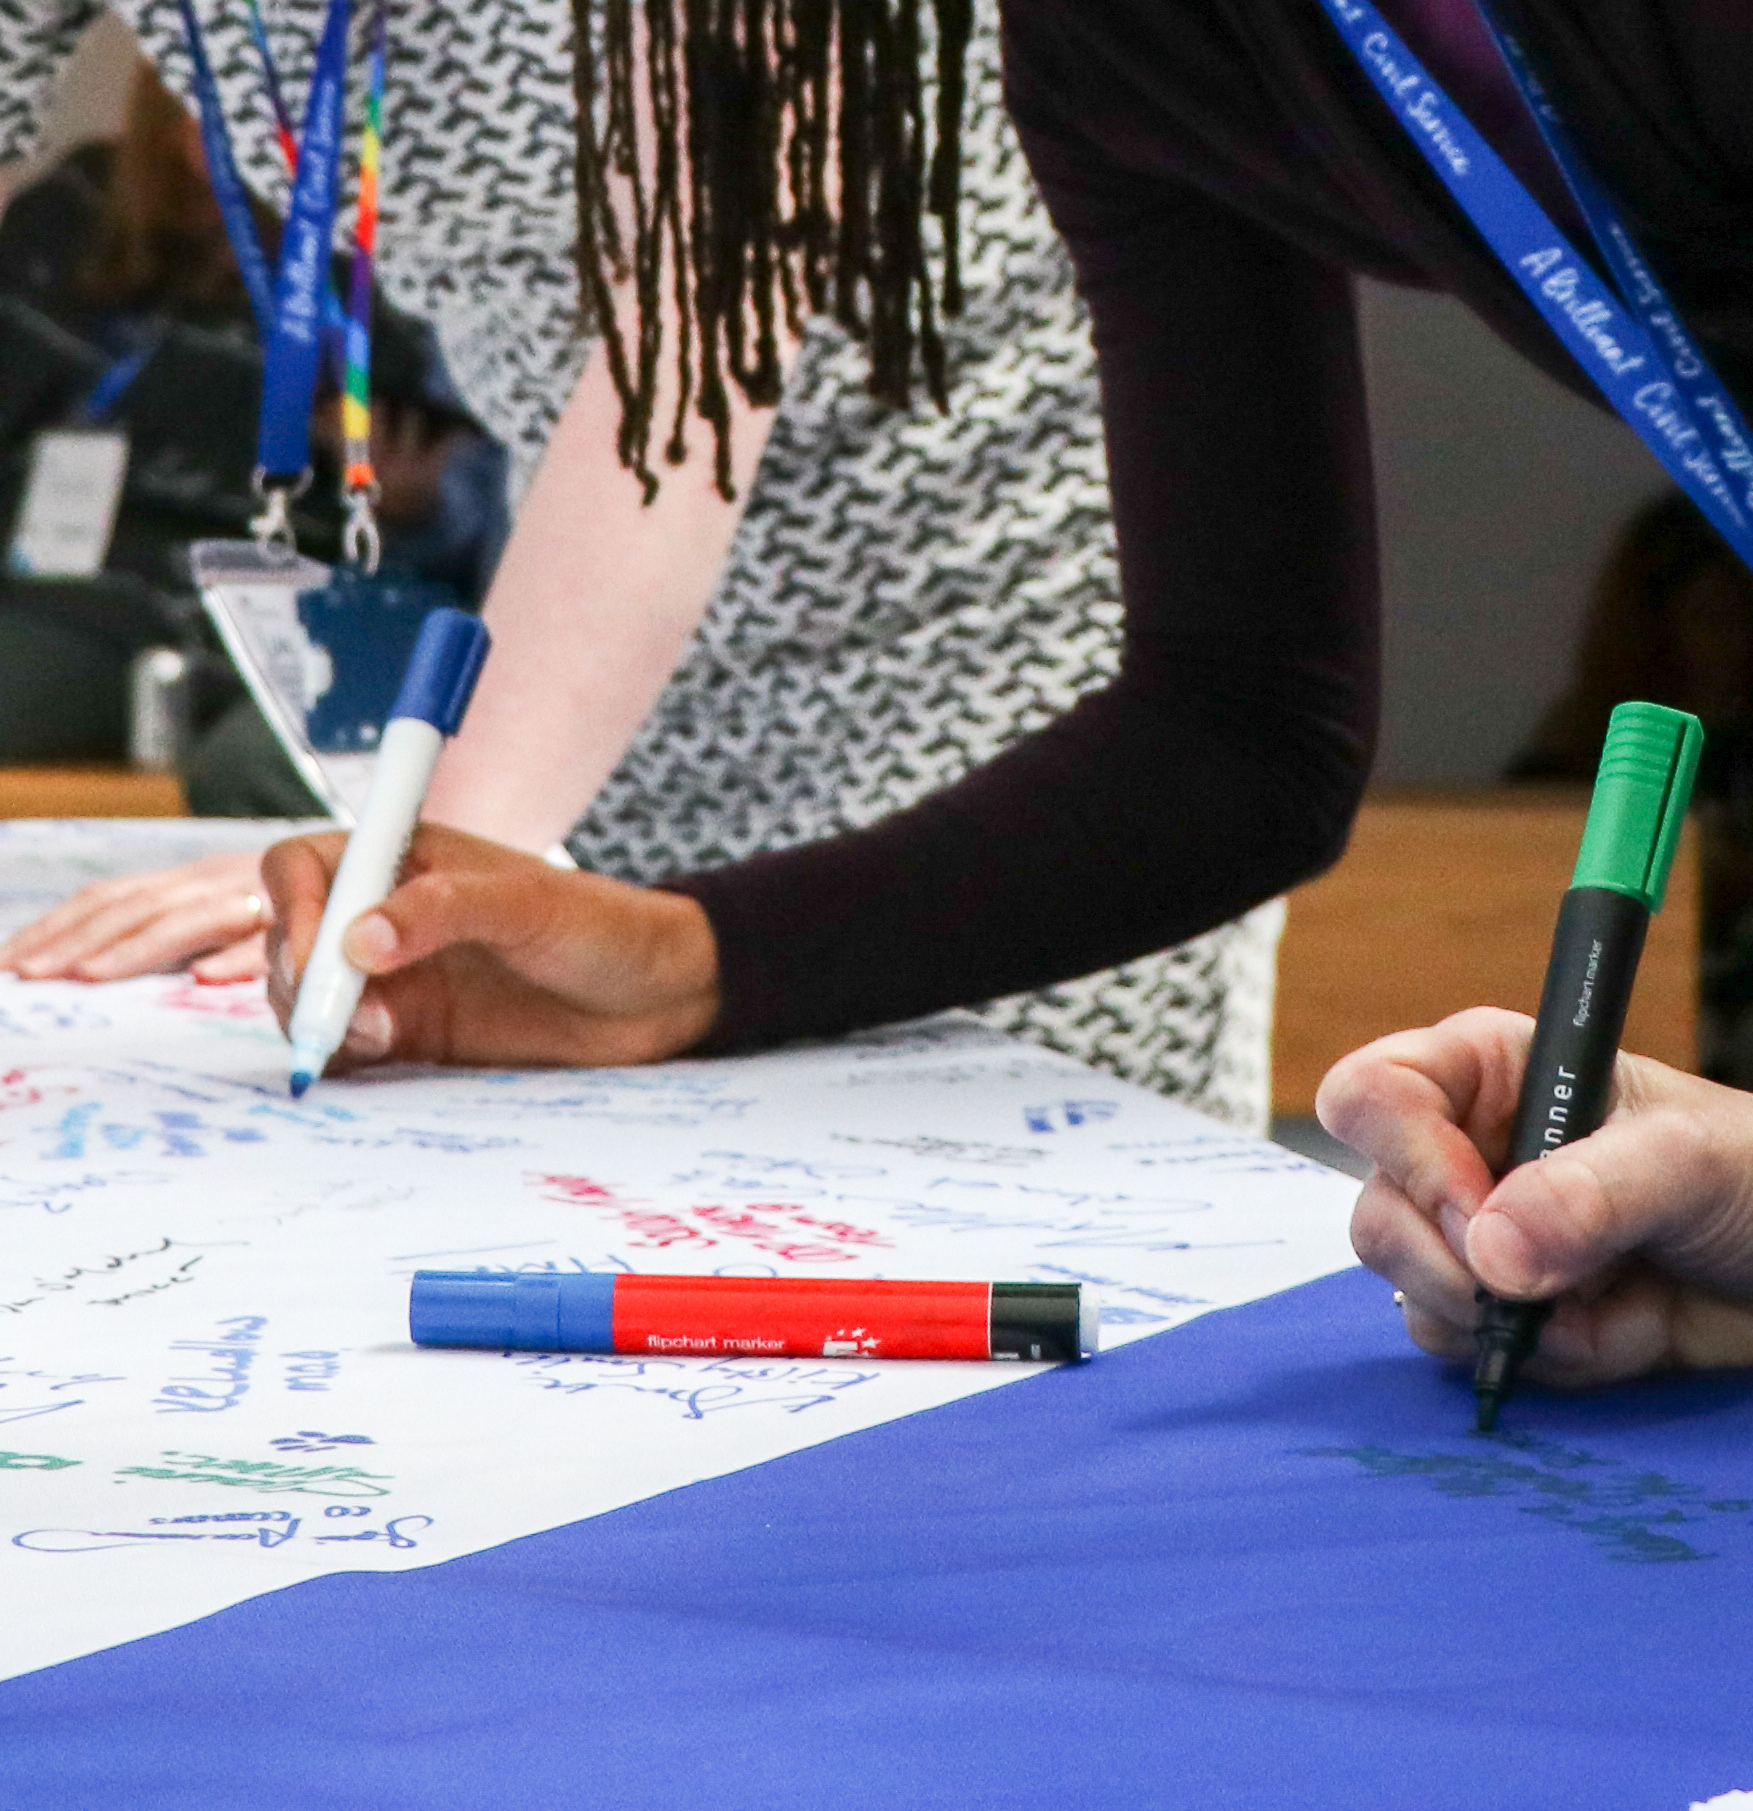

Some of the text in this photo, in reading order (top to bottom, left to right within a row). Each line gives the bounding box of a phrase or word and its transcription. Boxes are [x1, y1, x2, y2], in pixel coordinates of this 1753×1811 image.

[1518, 246, 1560, 281] A
[1633, 382, 1698, 461] Civil
[647, 1334, 785, 1350] flipchart marker
